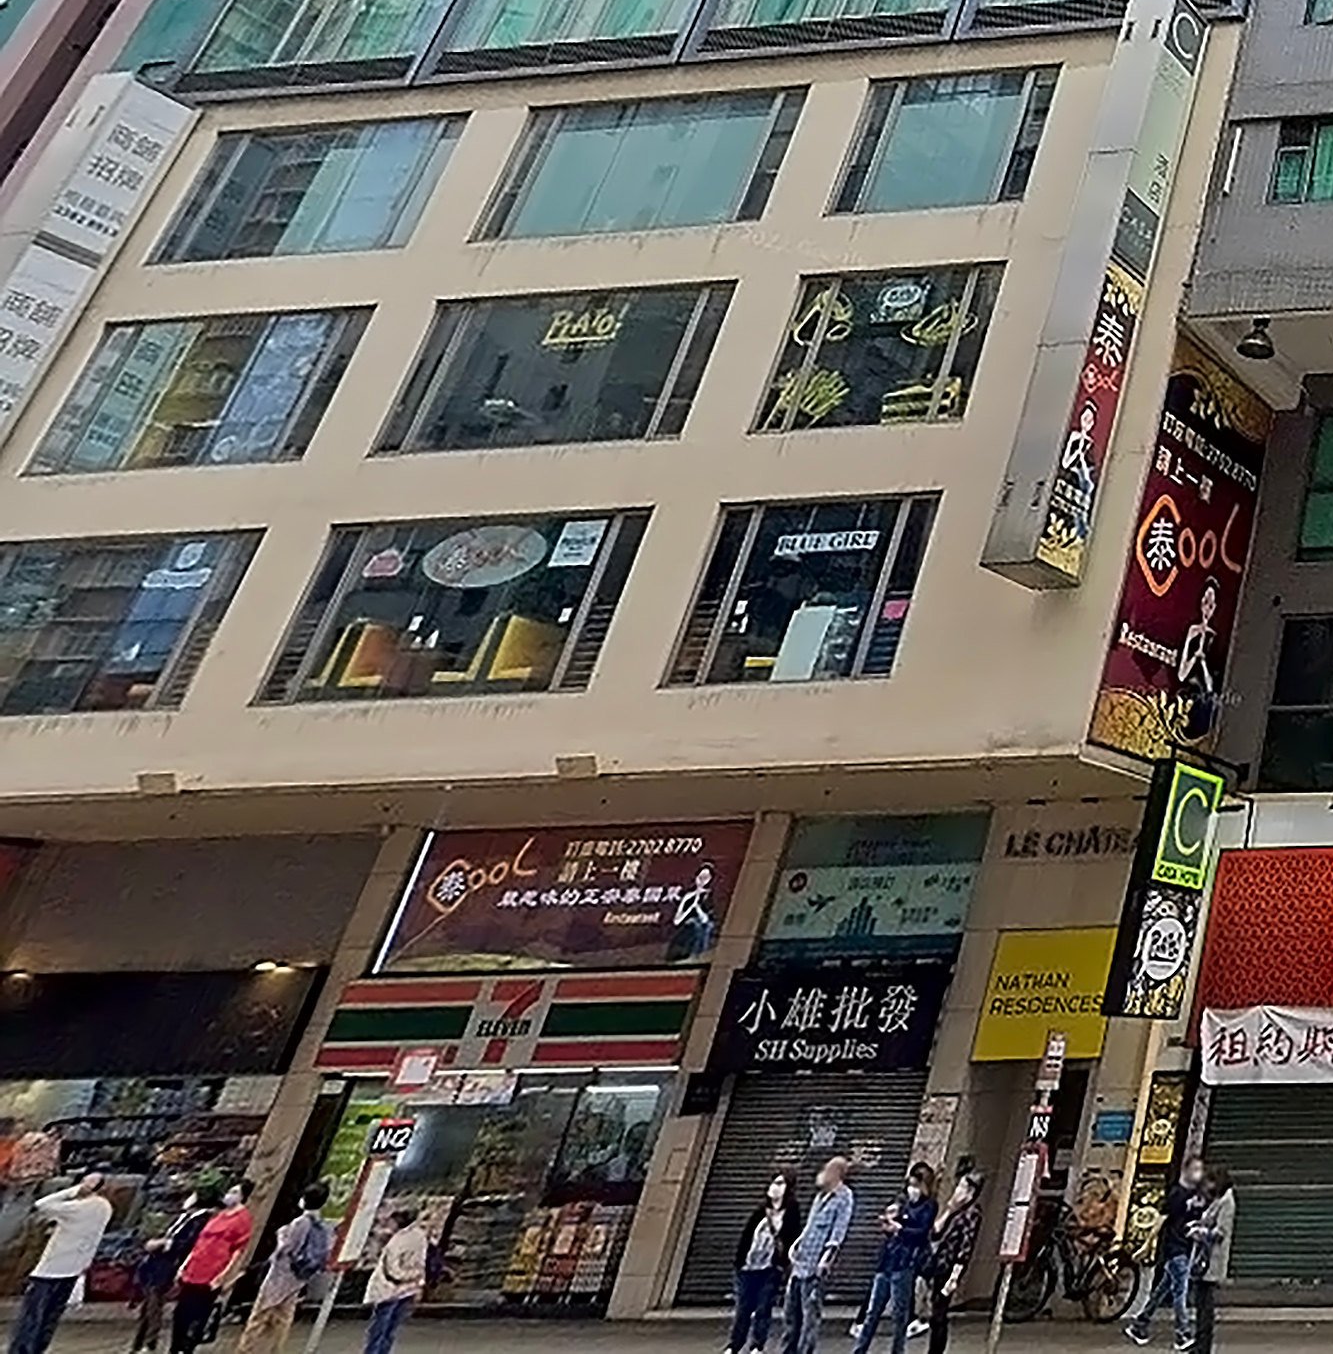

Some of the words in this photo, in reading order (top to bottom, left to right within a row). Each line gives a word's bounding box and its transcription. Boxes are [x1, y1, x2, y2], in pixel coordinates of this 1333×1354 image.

[995, 973, 1070, 990] NATHAN
[737, 984, 919, 1034] 小雄批發
[788, 1038, 879, 1064] Supplies
